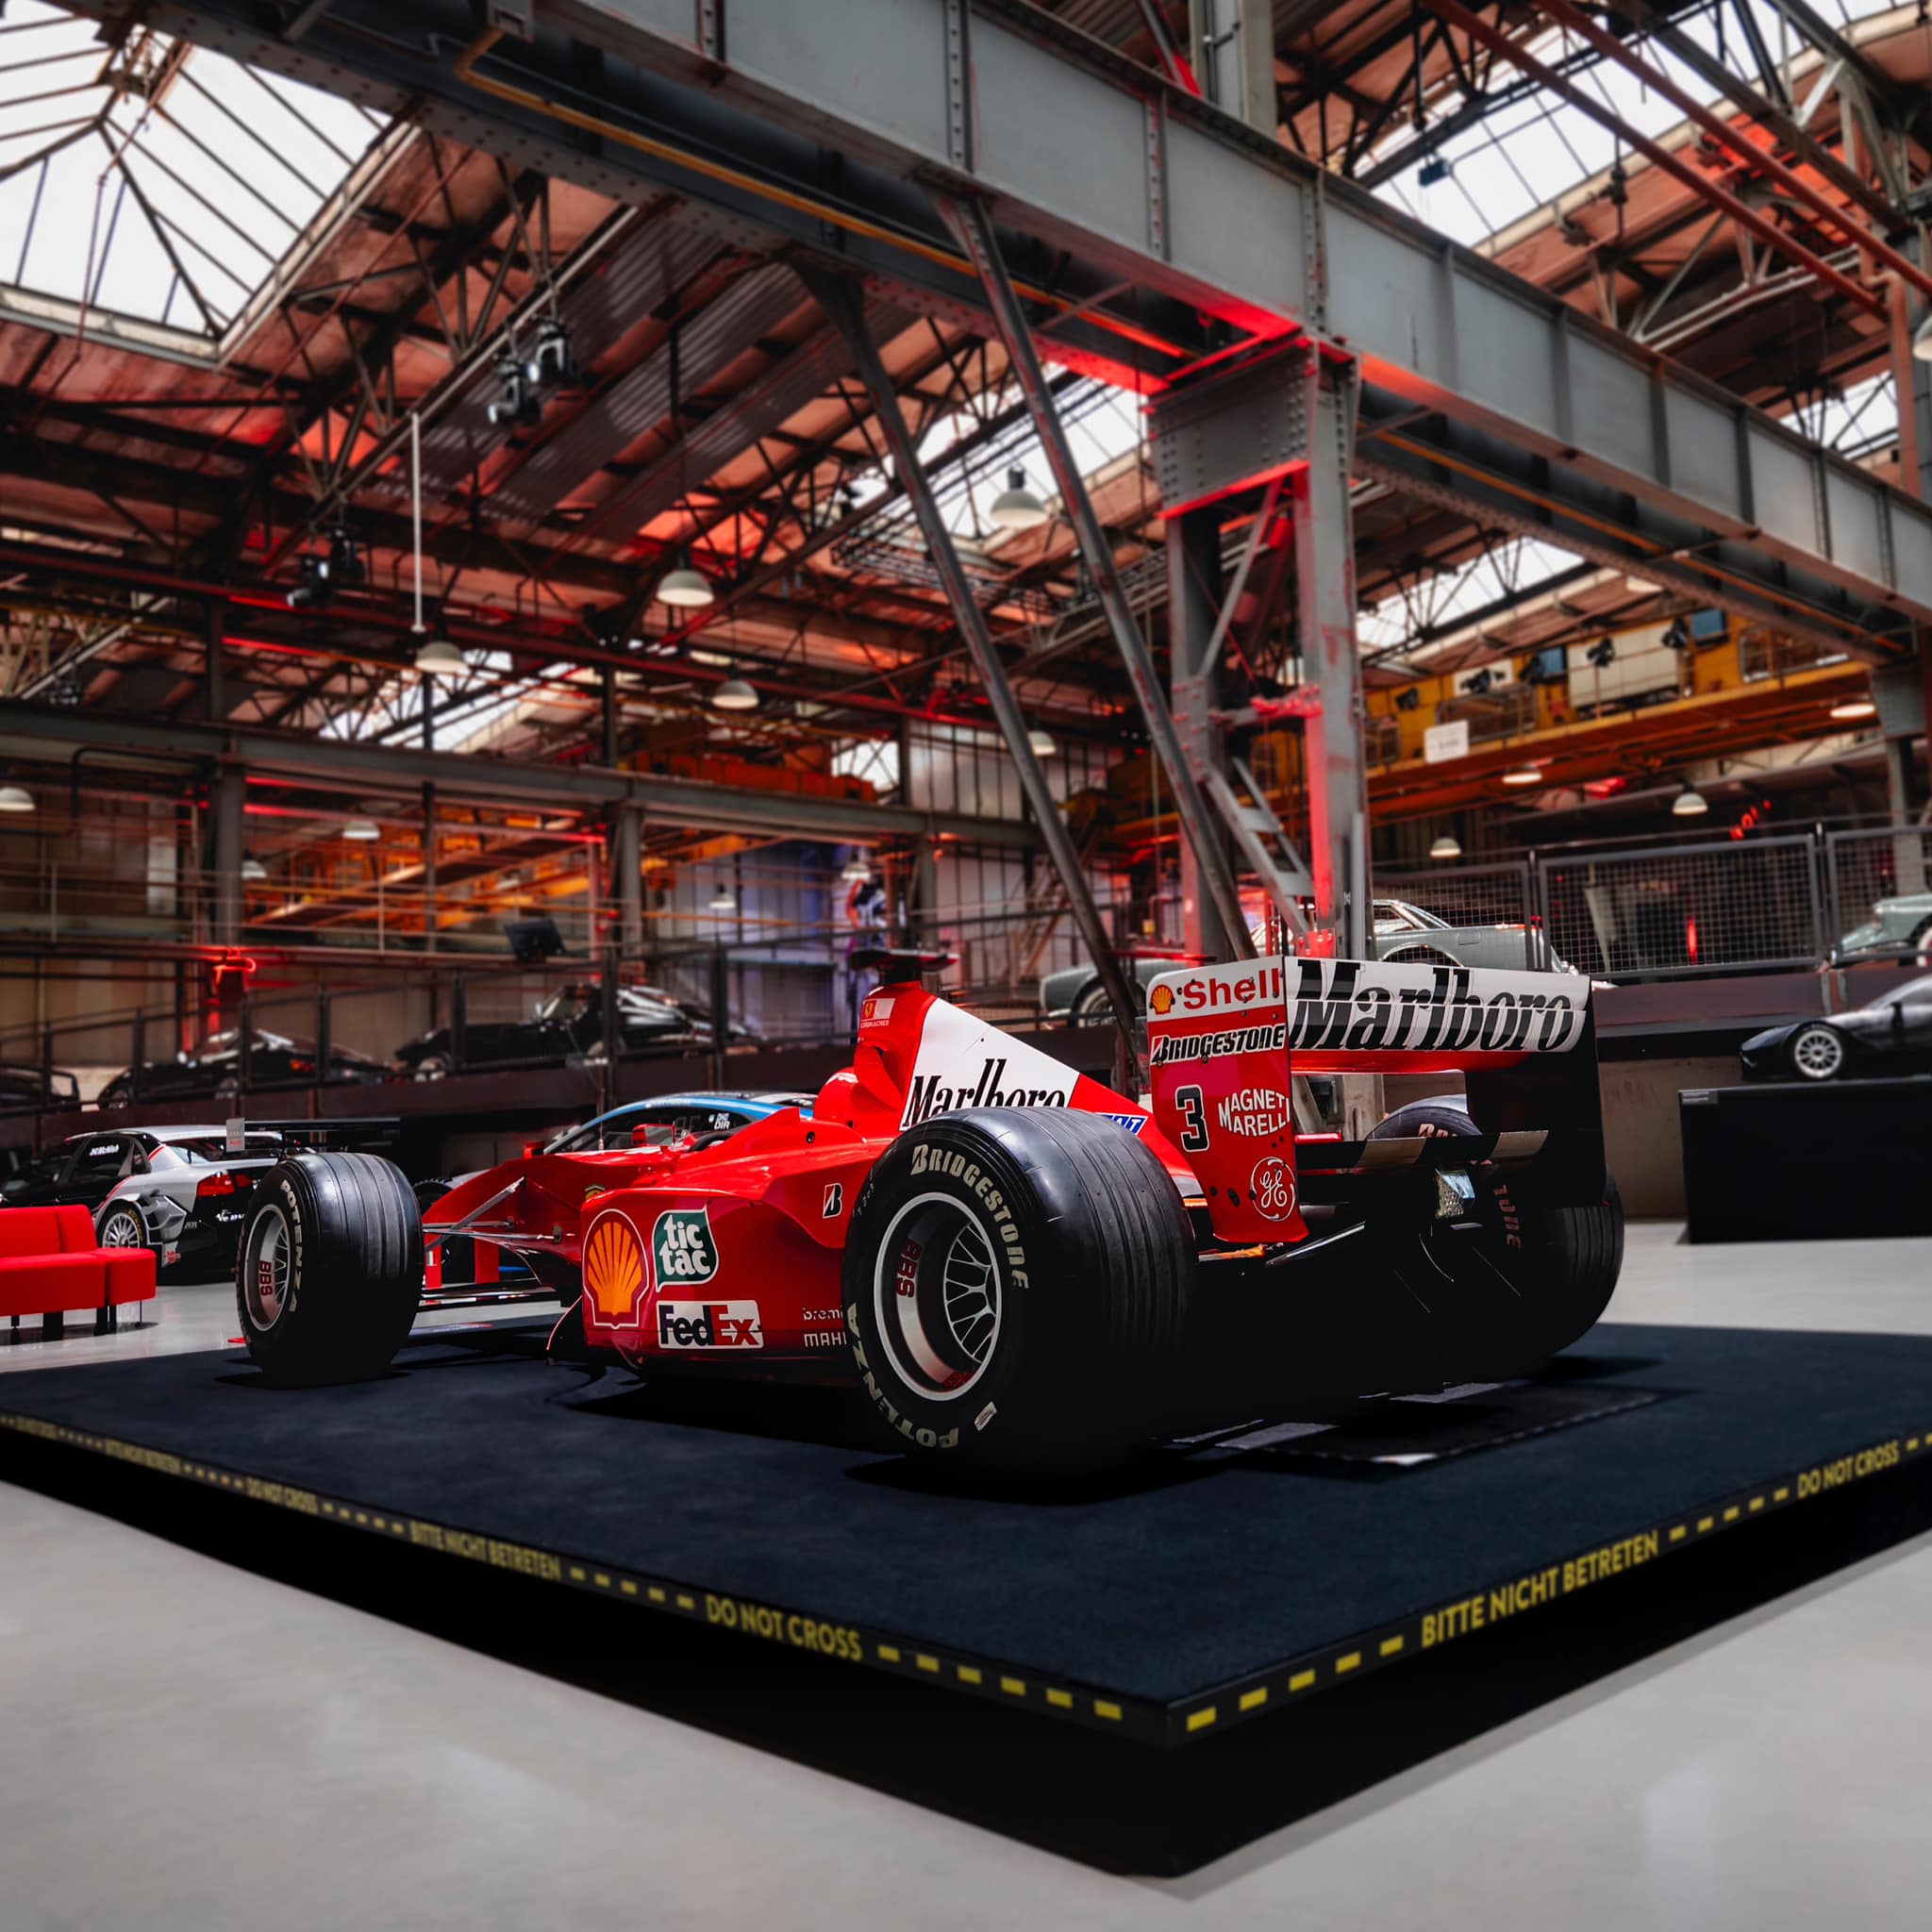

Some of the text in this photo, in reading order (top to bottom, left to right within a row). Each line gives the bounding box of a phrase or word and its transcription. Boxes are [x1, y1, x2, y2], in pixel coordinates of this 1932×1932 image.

[1183, 968, 1280, 1009] Shell
[1289, 958, 1574, 1050] Marlboro
[1151, 1024, 1285, 1065] BRIDGESTONE
[1175, 1085, 1209, 1152] 3
[1218, 1089, 1290, 1119] MAGNETI
[1218, 1108, 1290, 1136] MARELLI
[664, 1214, 702, 1249] tic
[910, 1143, 1029, 1290] BRIDGESTONE
[258, 1259, 274, 1296] BBS
[659, 1240, 710, 1275] tac
[896, 1238, 922, 1298] BBS
[659, 1305, 760, 1347] FedEx
[847, 1302, 959, 1448] POTENZA
[1797, 1440, 1900, 1499] DO NOT CROSS
[1422, 1529, 1658, 1648] BITTE NICHT BETRETEN
[706, 1594, 863, 1661] DO NOT CROSS
